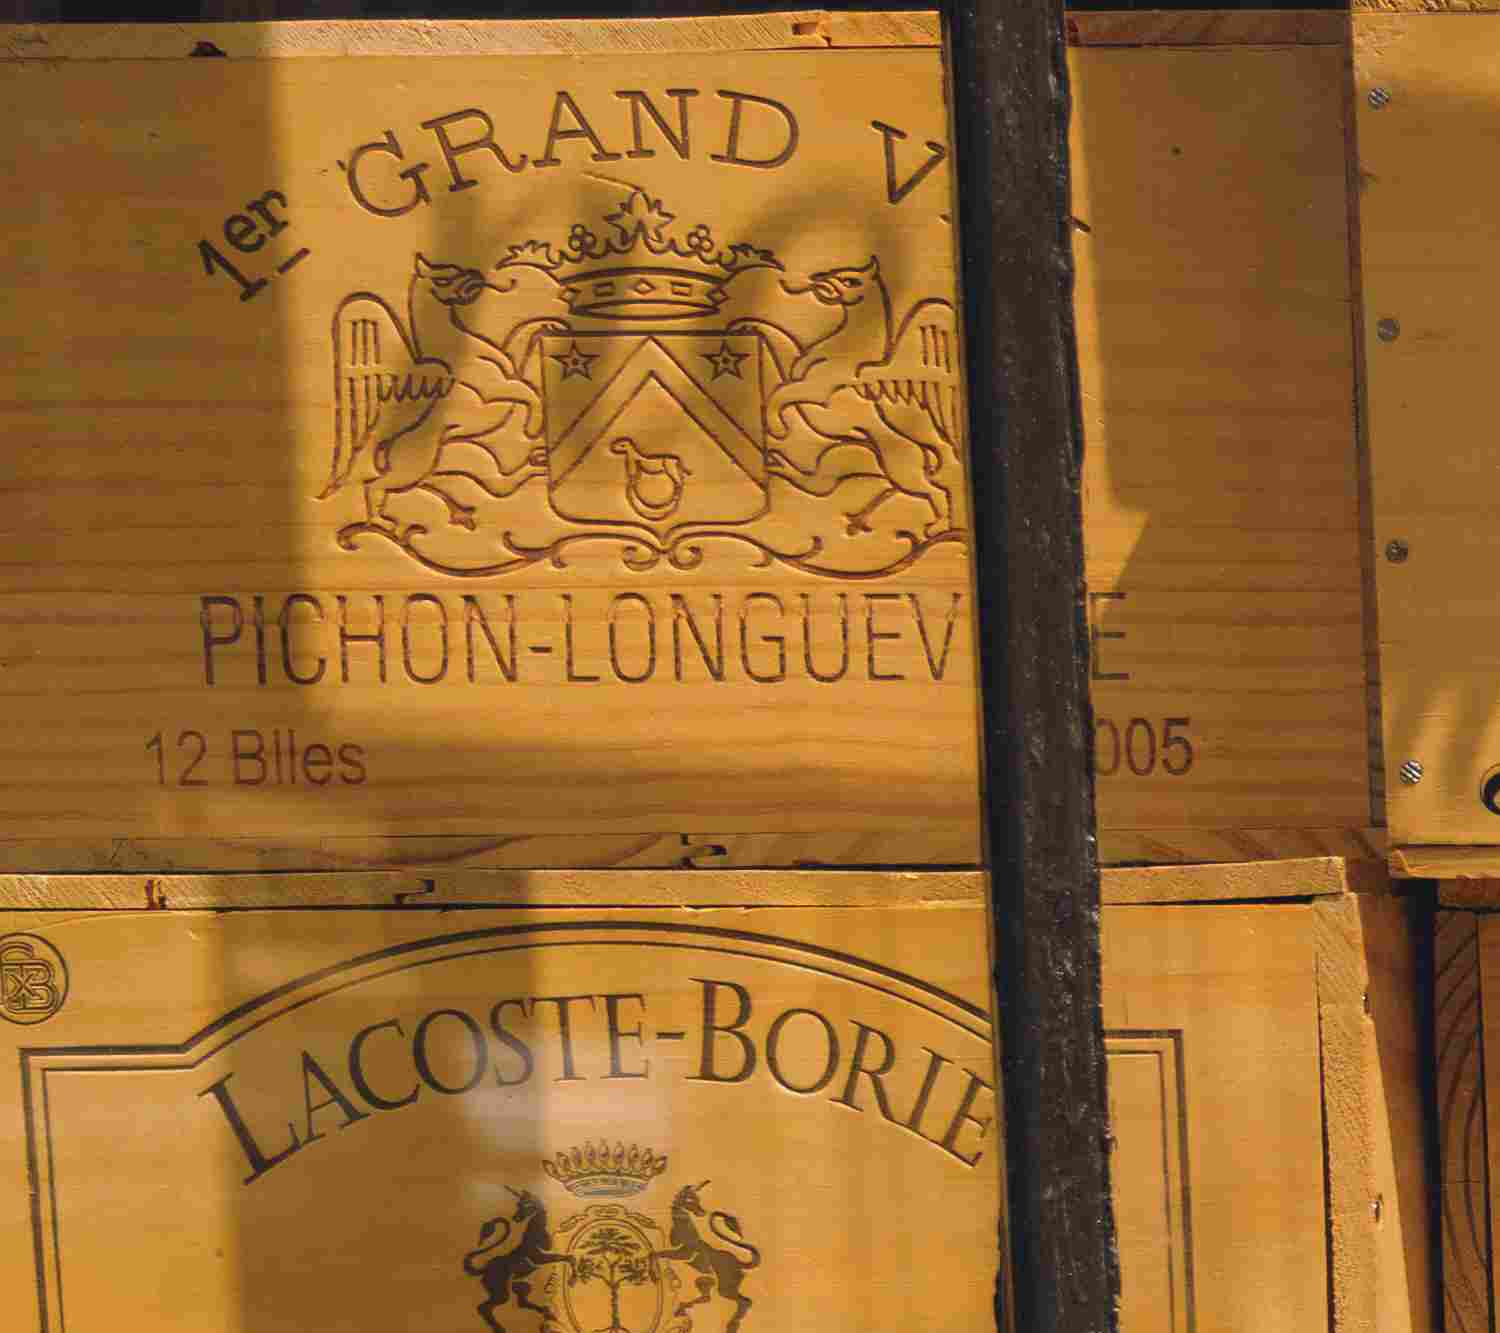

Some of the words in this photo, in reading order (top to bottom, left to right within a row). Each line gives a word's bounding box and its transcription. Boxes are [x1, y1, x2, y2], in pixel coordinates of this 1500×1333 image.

[199, 186, 312, 303] 1er
[337, 88, 802, 219] GRAND
[200, 590, 1132, 690] PICHON-LONGUEVE
[146, 729, 208, 789] 12
[1093, 715, 1195, 780] 005
[199, 976, 998, 1187] LACOSTE-BORIE
